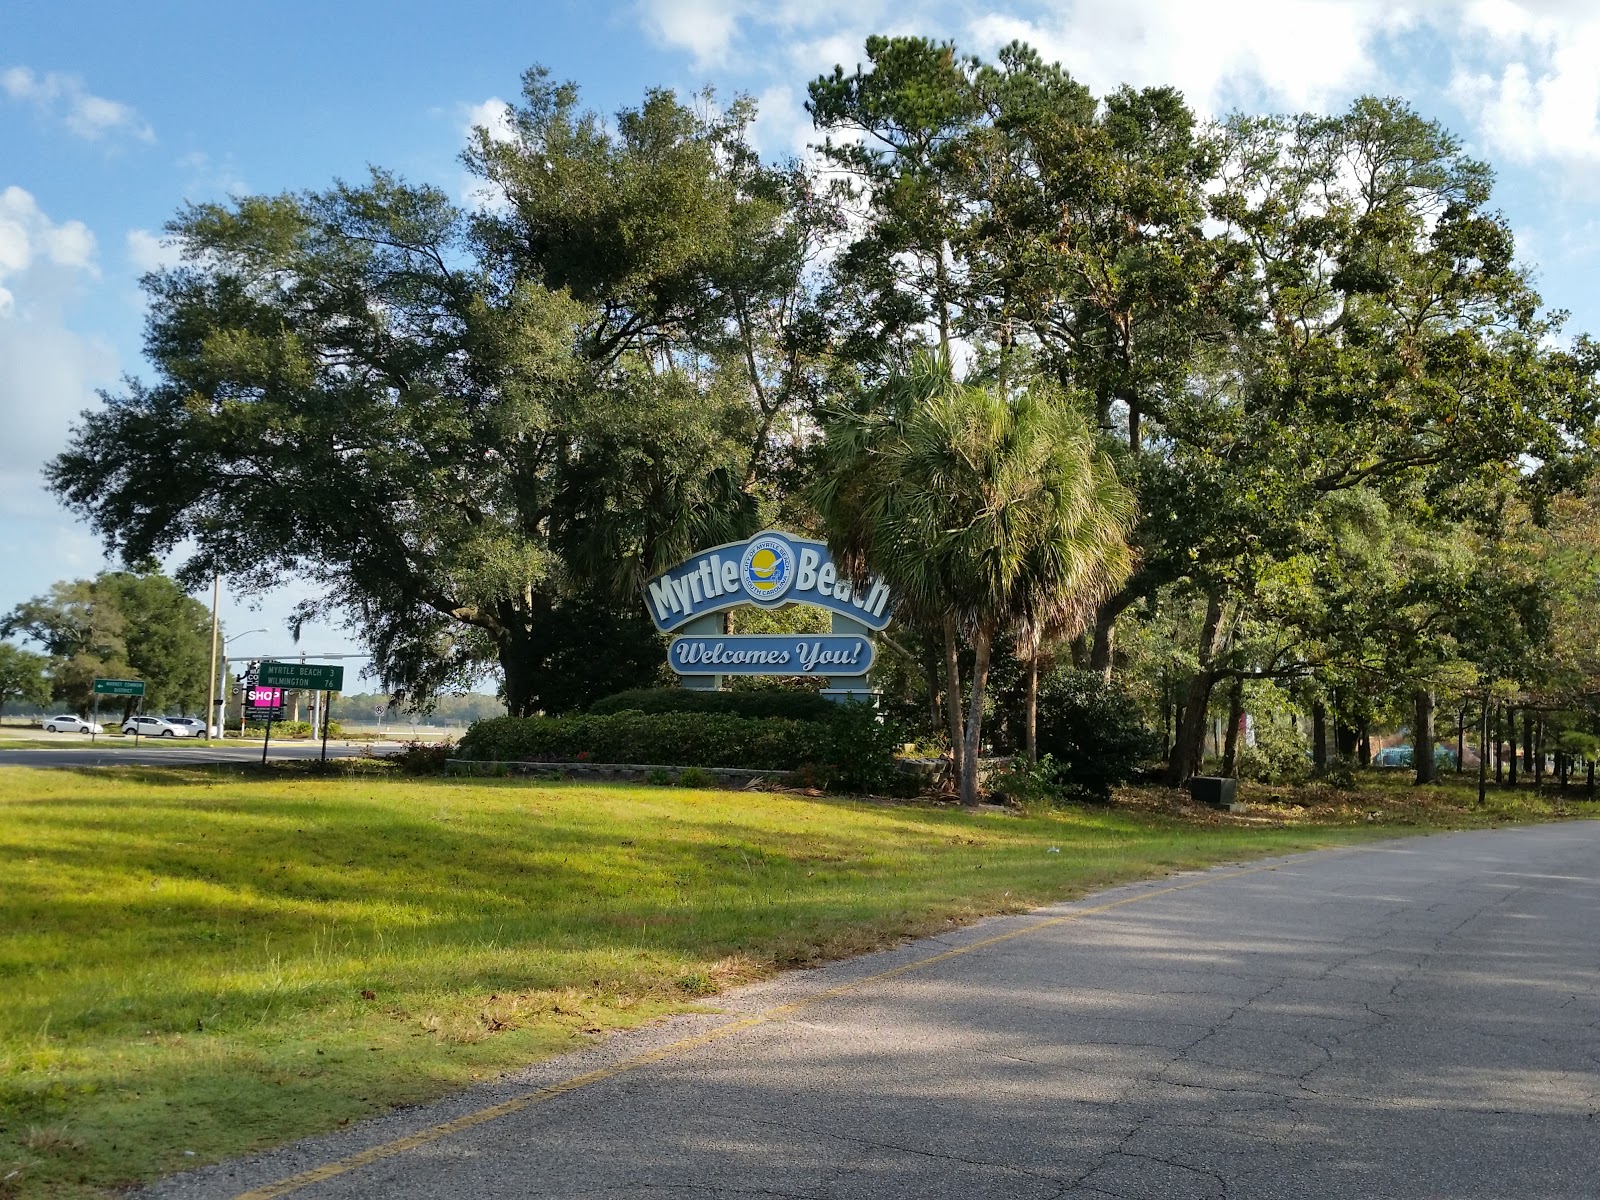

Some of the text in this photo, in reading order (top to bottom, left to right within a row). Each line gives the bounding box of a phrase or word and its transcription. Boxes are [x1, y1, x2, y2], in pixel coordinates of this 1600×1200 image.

[780, 549, 790, 571] BEACH
[648, 554, 740, 621] Myrtle
[746, 576, 787, 595] SOUTH CAROLINA
[676, 642, 862, 672] Welcomes You!
[268, 666, 294, 675] MYRTLE
[299, 668, 322, 676] BEACH
[268, 677, 309, 686] WILMINGTON
[248, 691, 280, 700] SHOP
